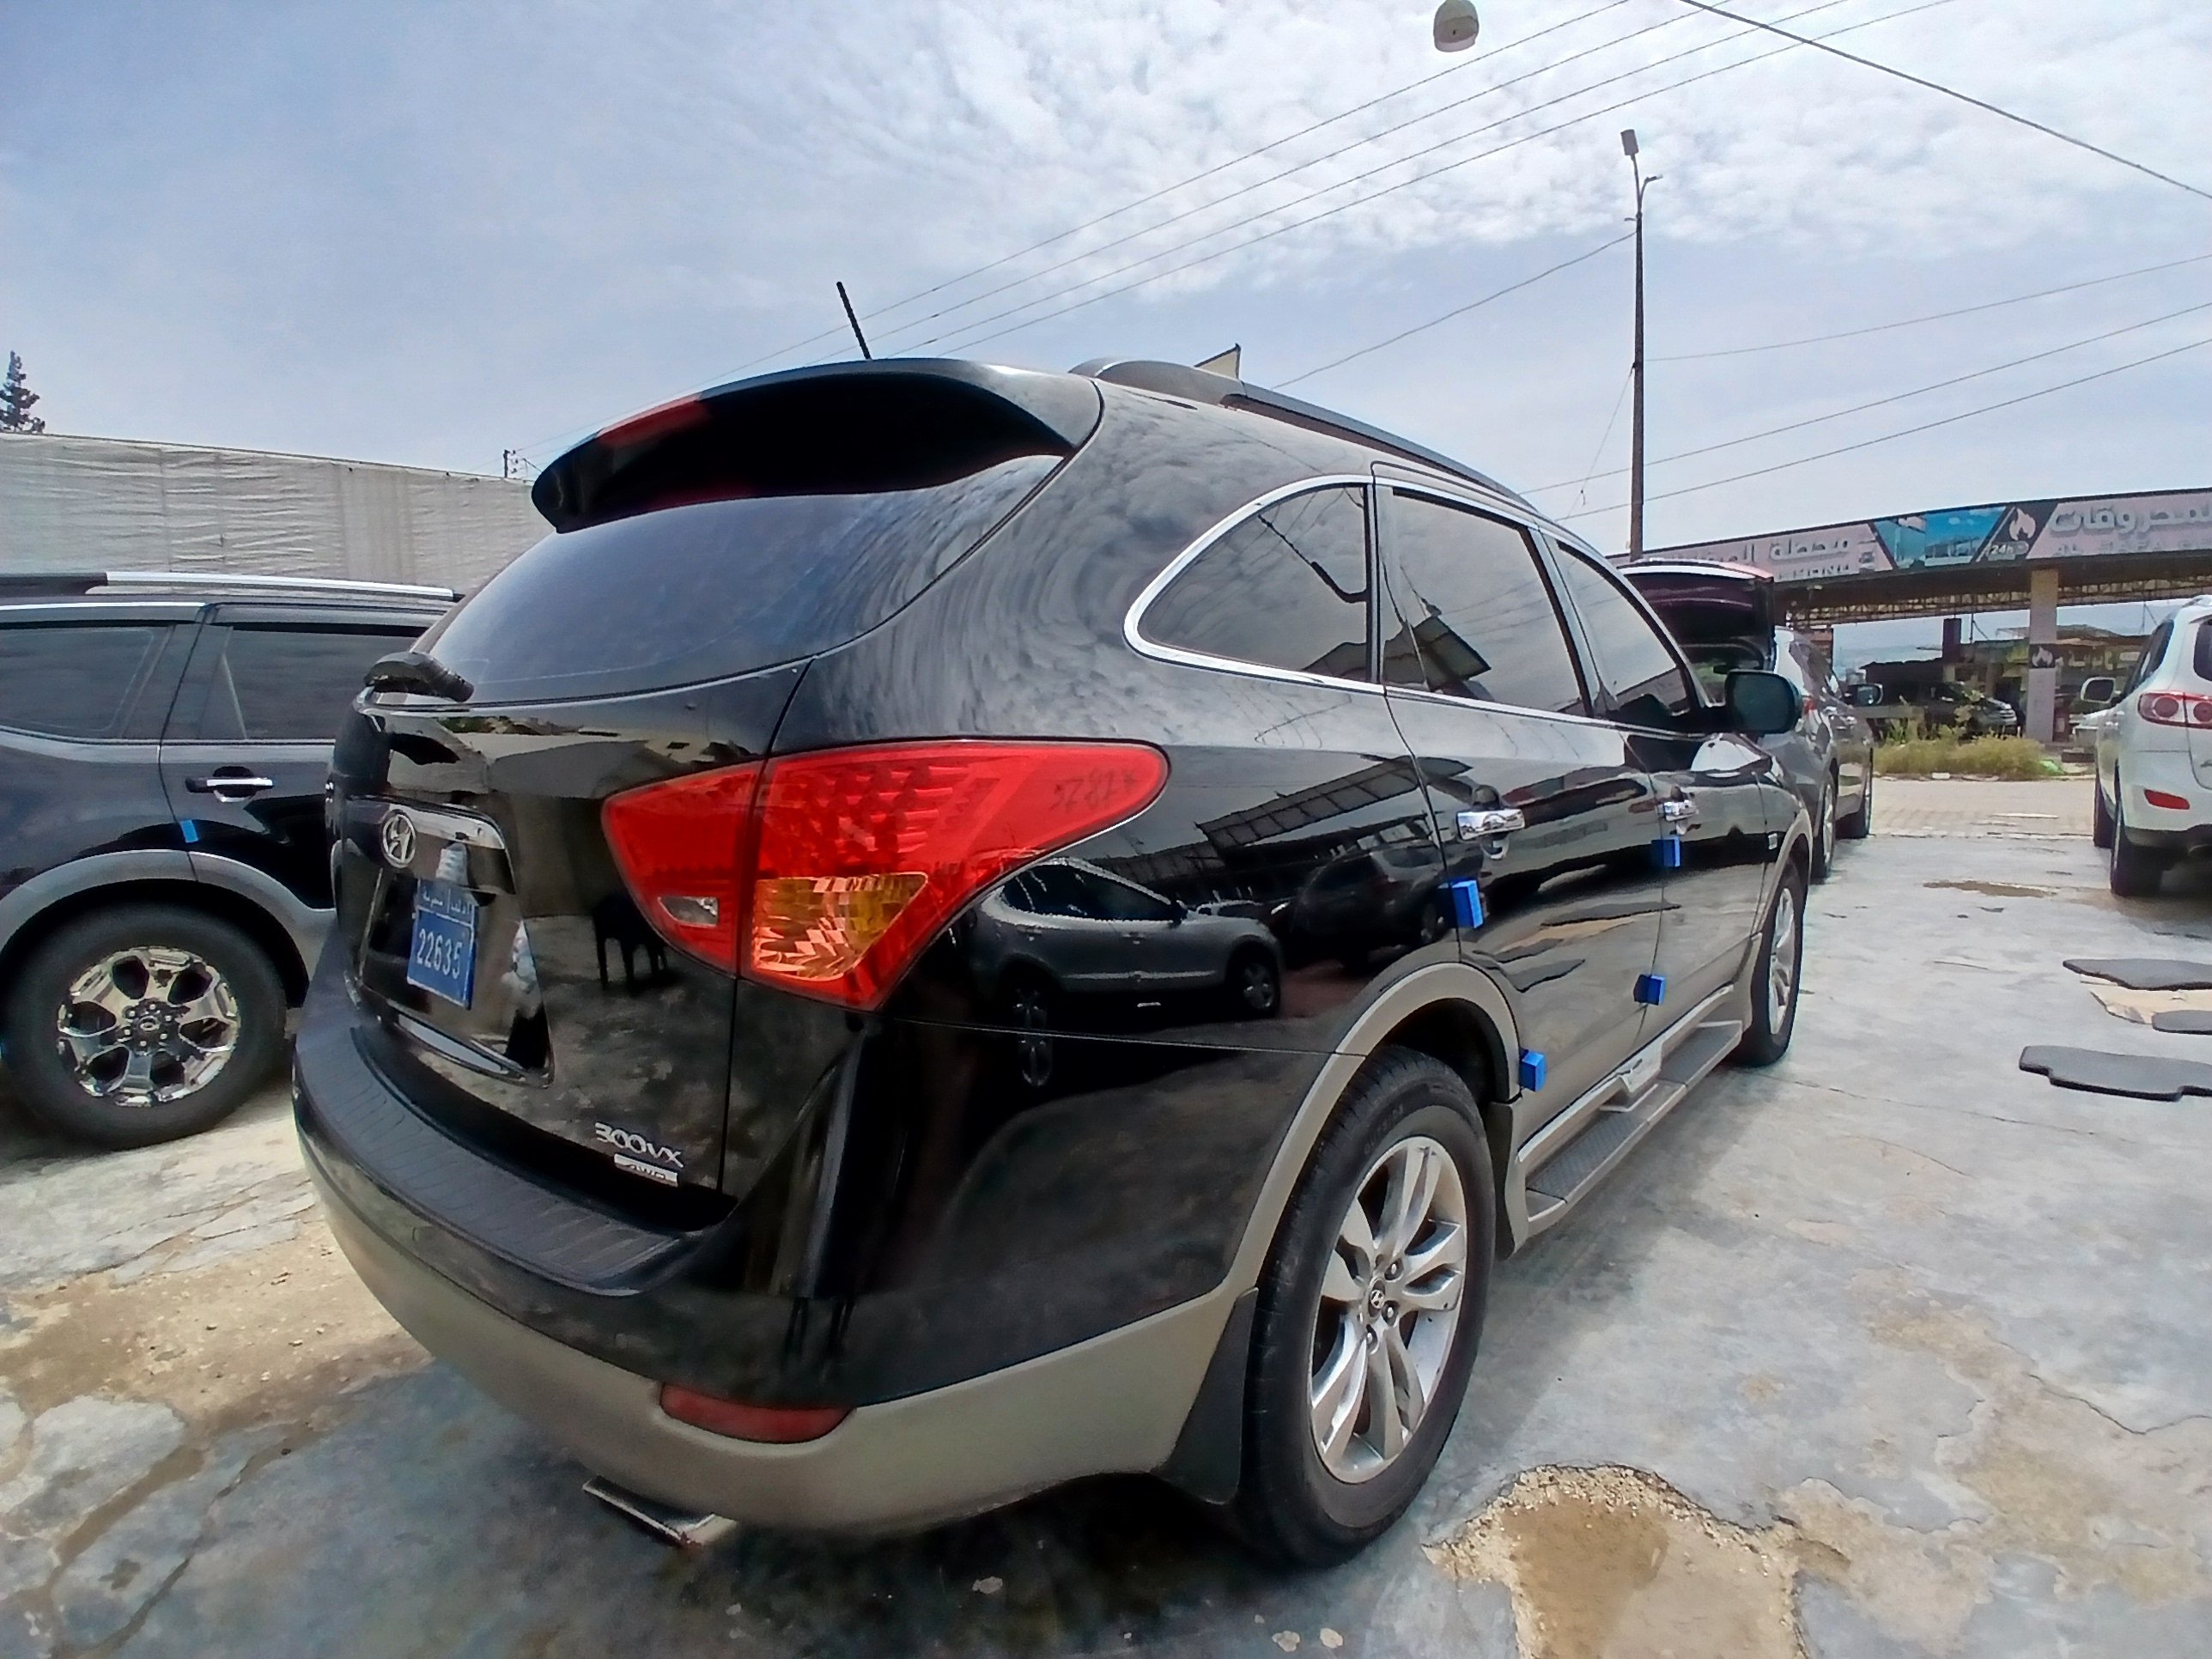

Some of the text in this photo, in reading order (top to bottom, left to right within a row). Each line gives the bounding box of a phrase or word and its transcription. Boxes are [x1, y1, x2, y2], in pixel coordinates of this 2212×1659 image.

[1769, 537, 1850, 562] محطة
[1990, 544, 2014, 556] 24h
[416, 927, 463, 980] 22635
[594, 1121, 684, 1169] 300VX
